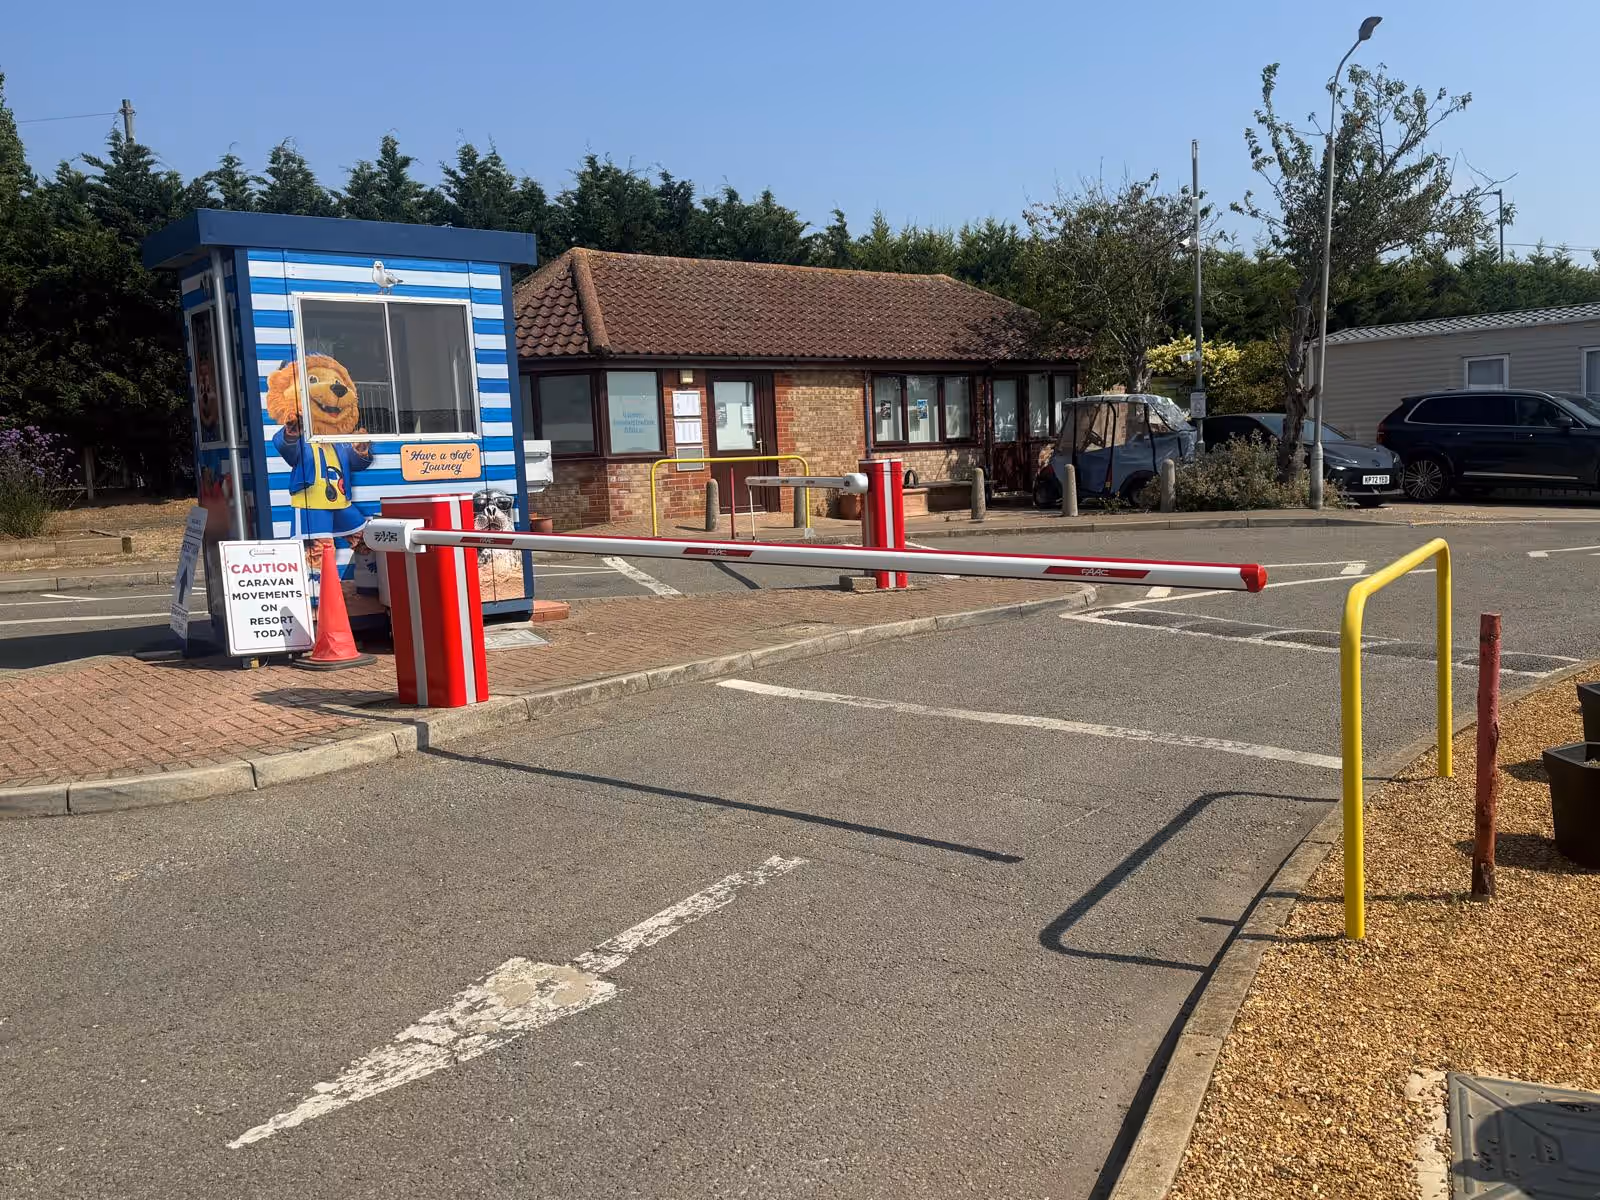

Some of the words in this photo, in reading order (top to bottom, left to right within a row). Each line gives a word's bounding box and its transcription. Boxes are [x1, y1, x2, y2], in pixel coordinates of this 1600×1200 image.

[410, 450, 436, 461] Have
[450, 450, 472, 462] Safe
[420, 461, 462, 475] Journey
[231, 562, 298, 574] CAUTION
[1081, 568, 1110, 577] FAAC
[238, 578, 294, 588] CARAVAN
[232, 590, 303, 601] MOVEMENTS
[261, 604, 278, 612] ON
[250, 615, 294, 626] RESORT
[253, 628, 293, 639] TODAY
